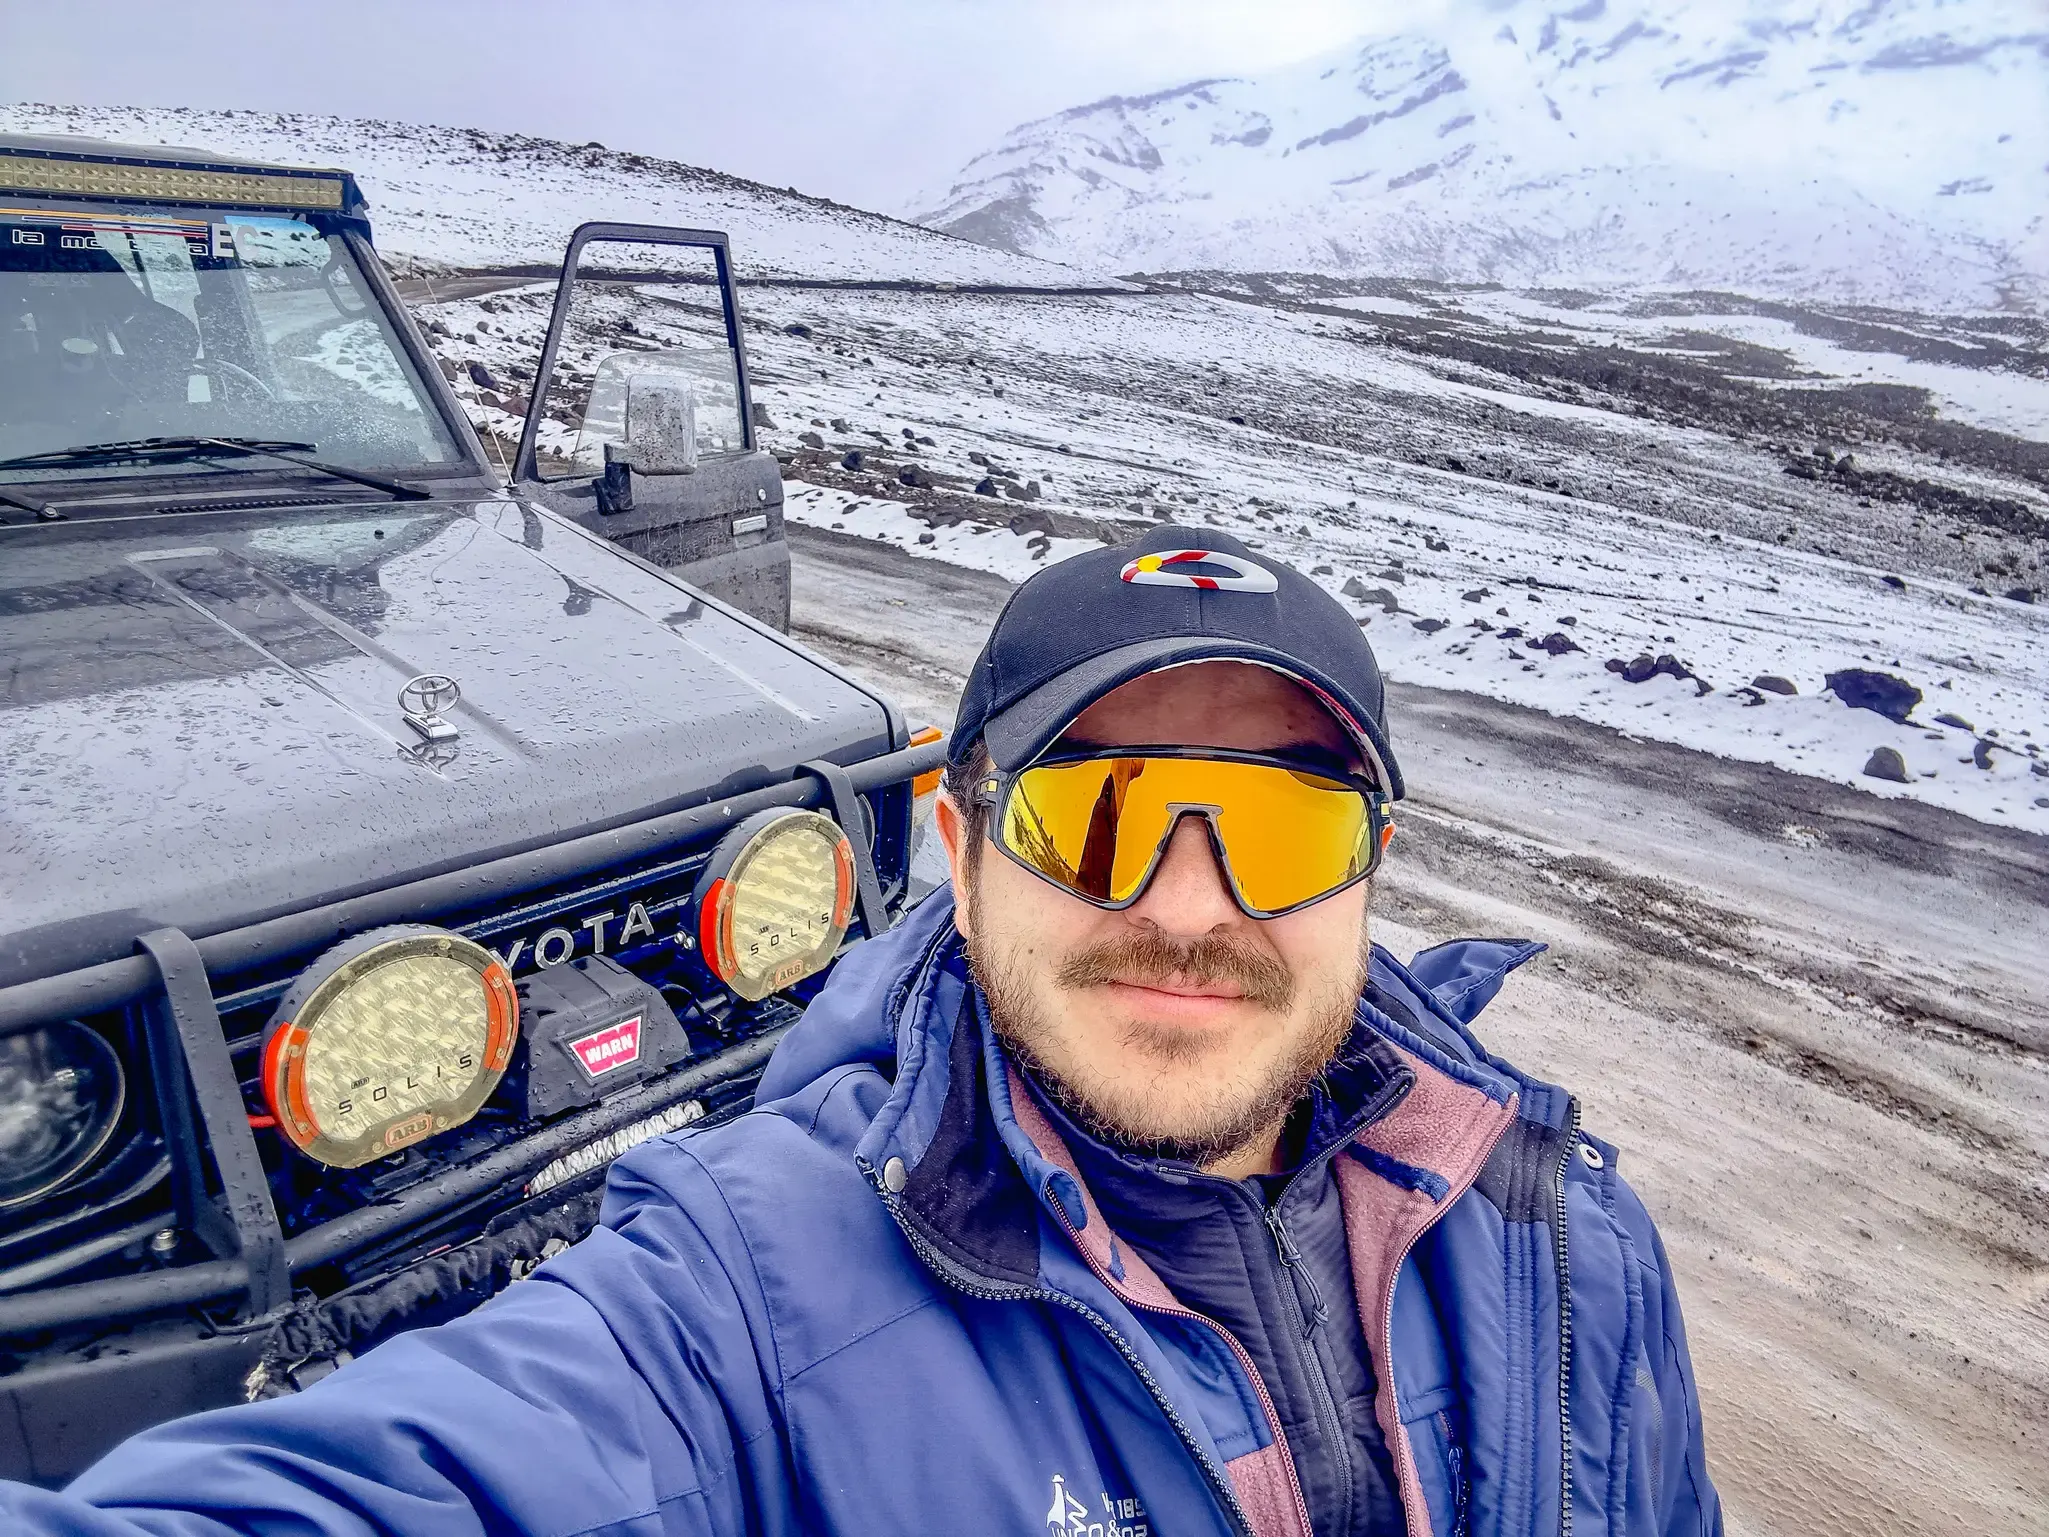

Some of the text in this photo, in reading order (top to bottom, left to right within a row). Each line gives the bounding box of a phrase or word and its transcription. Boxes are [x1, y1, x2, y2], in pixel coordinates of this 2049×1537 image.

[12, 229, 208, 256] la mota
[490, 902, 655, 971] YOTA
[751, 912, 829, 956] SOLIS
[585, 1033, 634, 1065] WARN
[338, 1054, 472, 1115] SOLIS
